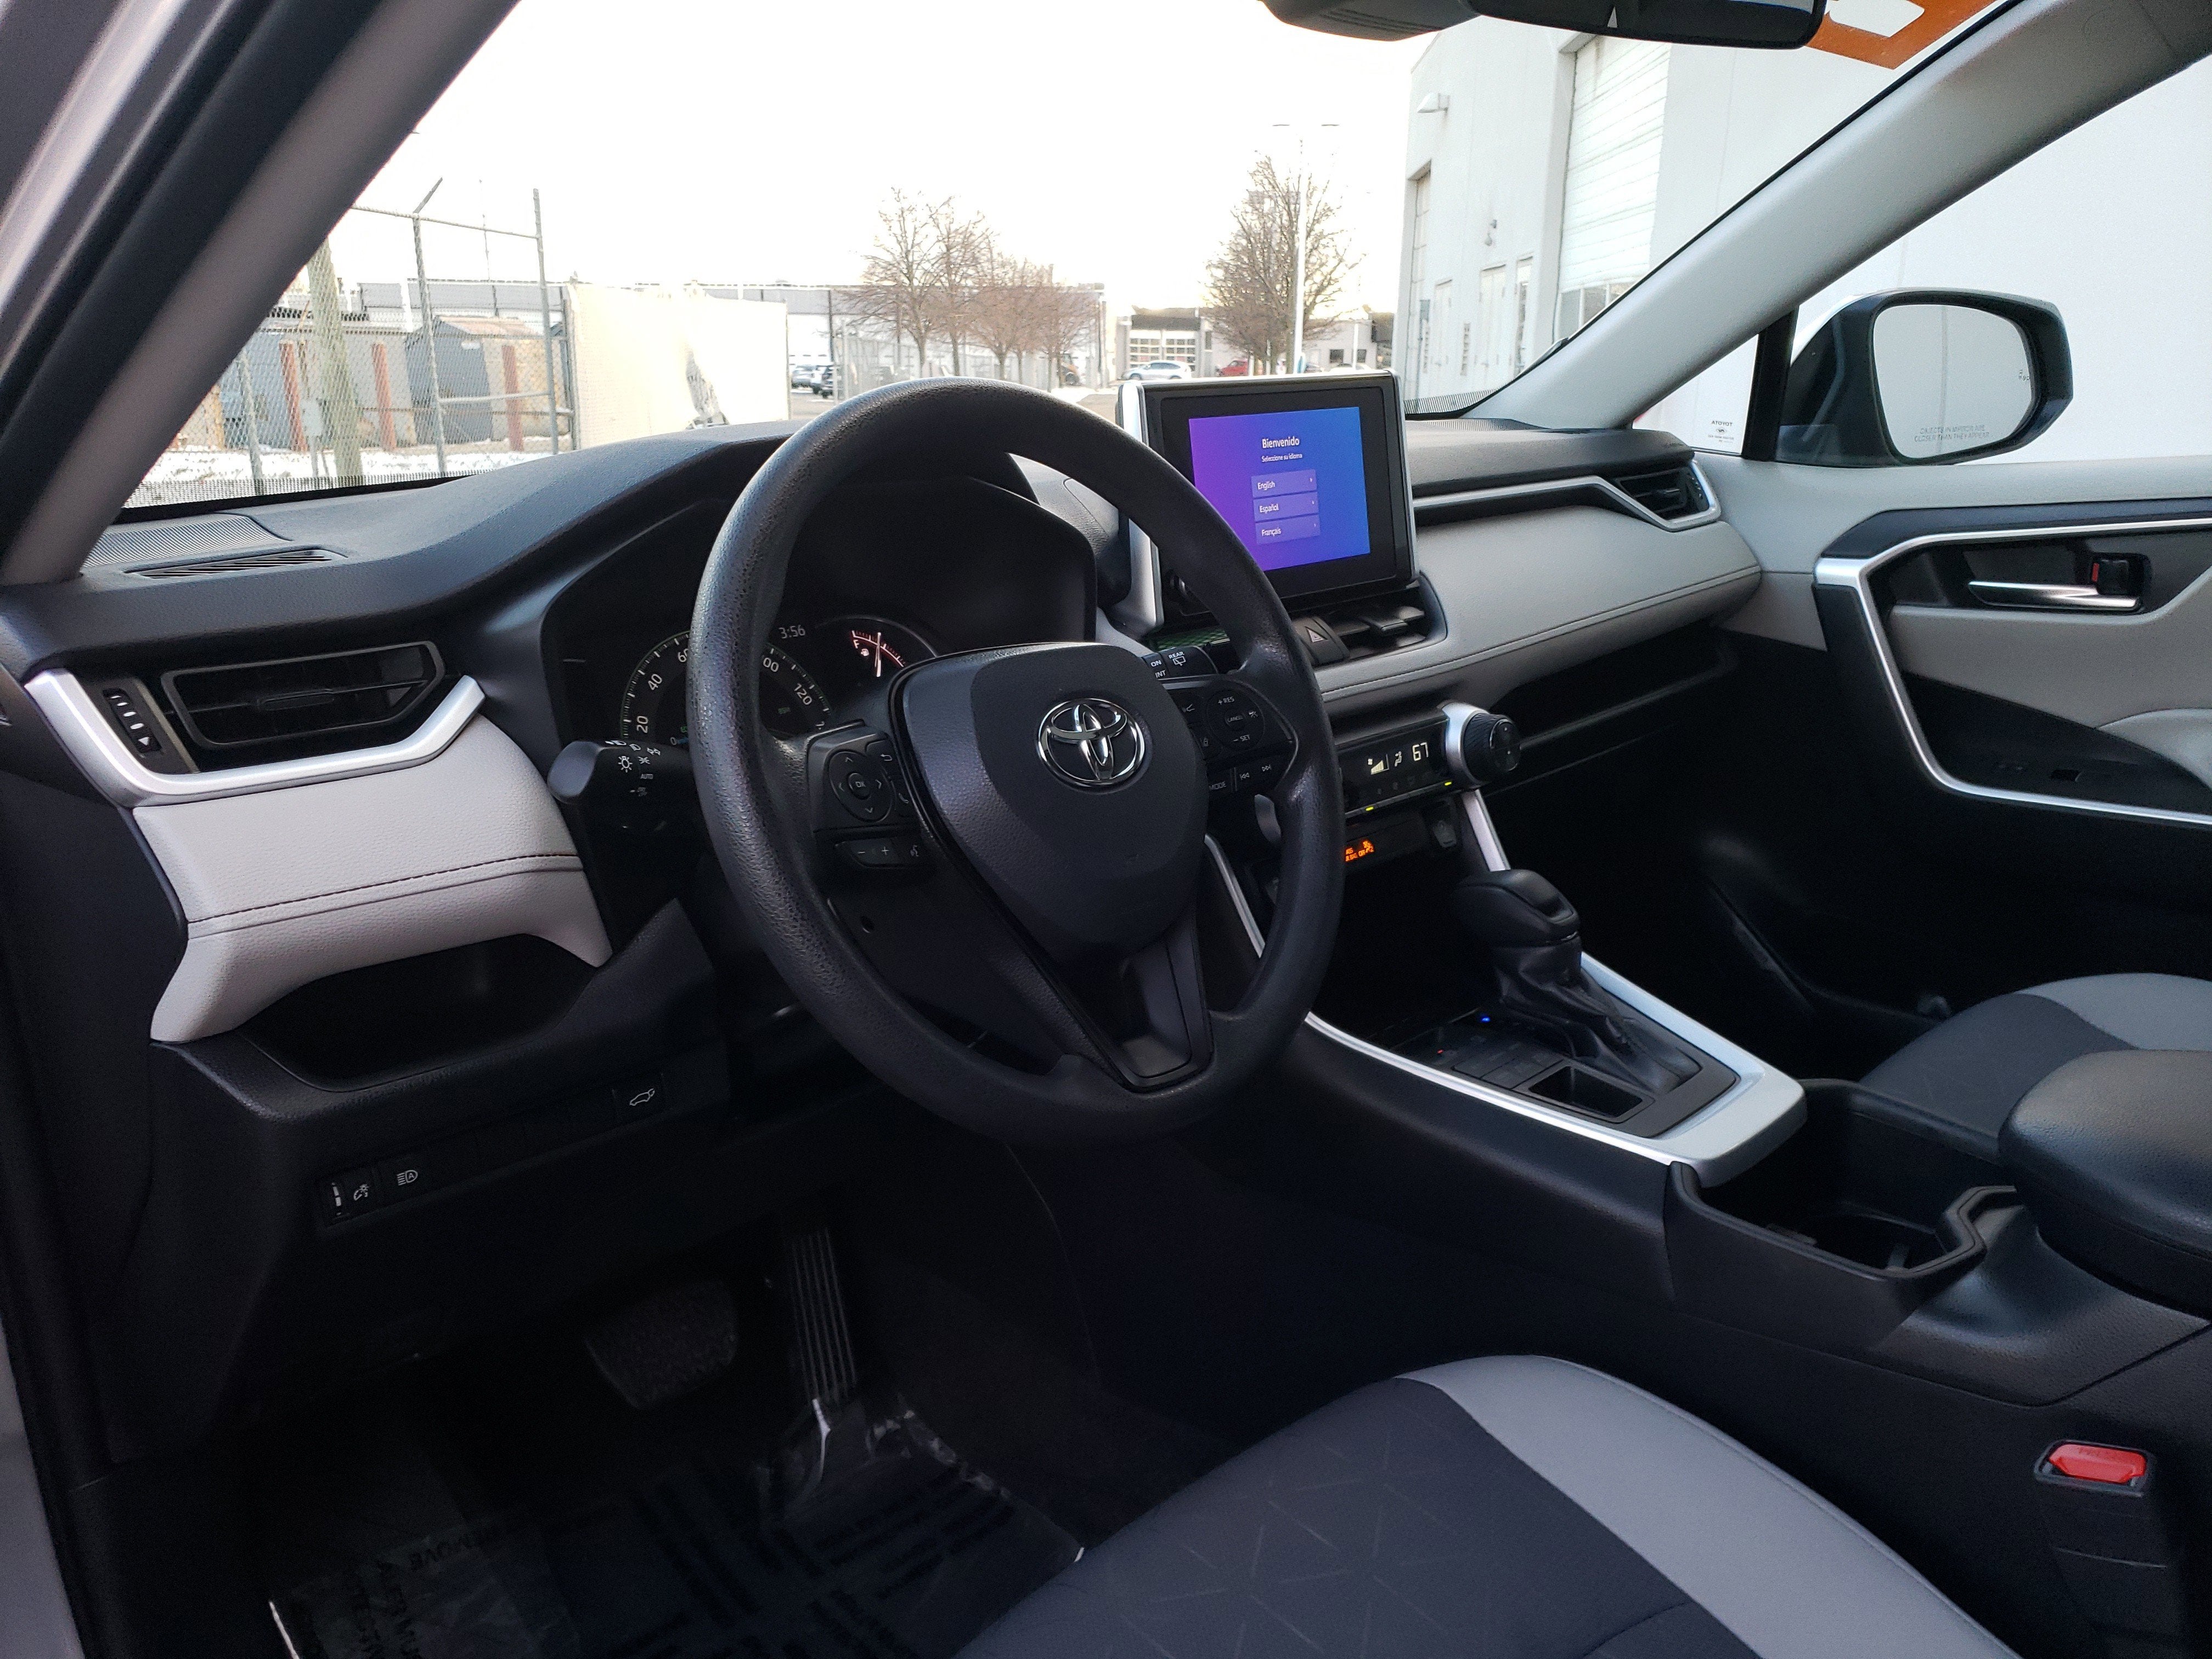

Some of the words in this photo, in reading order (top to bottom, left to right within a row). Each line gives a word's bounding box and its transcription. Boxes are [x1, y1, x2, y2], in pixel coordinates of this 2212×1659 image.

[1262, 436, 1300, 448] Bienvenido
[1257, 481, 1276, 490] English
[1259, 504, 1279, 514] Español
[1262, 527, 1281, 537] Français
[778, 625, 806, 639] 3:56
[1155, 670, 1166, 678] INT
[648, 674, 663, 691] 40
[794, 683, 812, 705] 120
[636, 715, 648, 734] 20
[1412, 742, 1429, 761] 67
